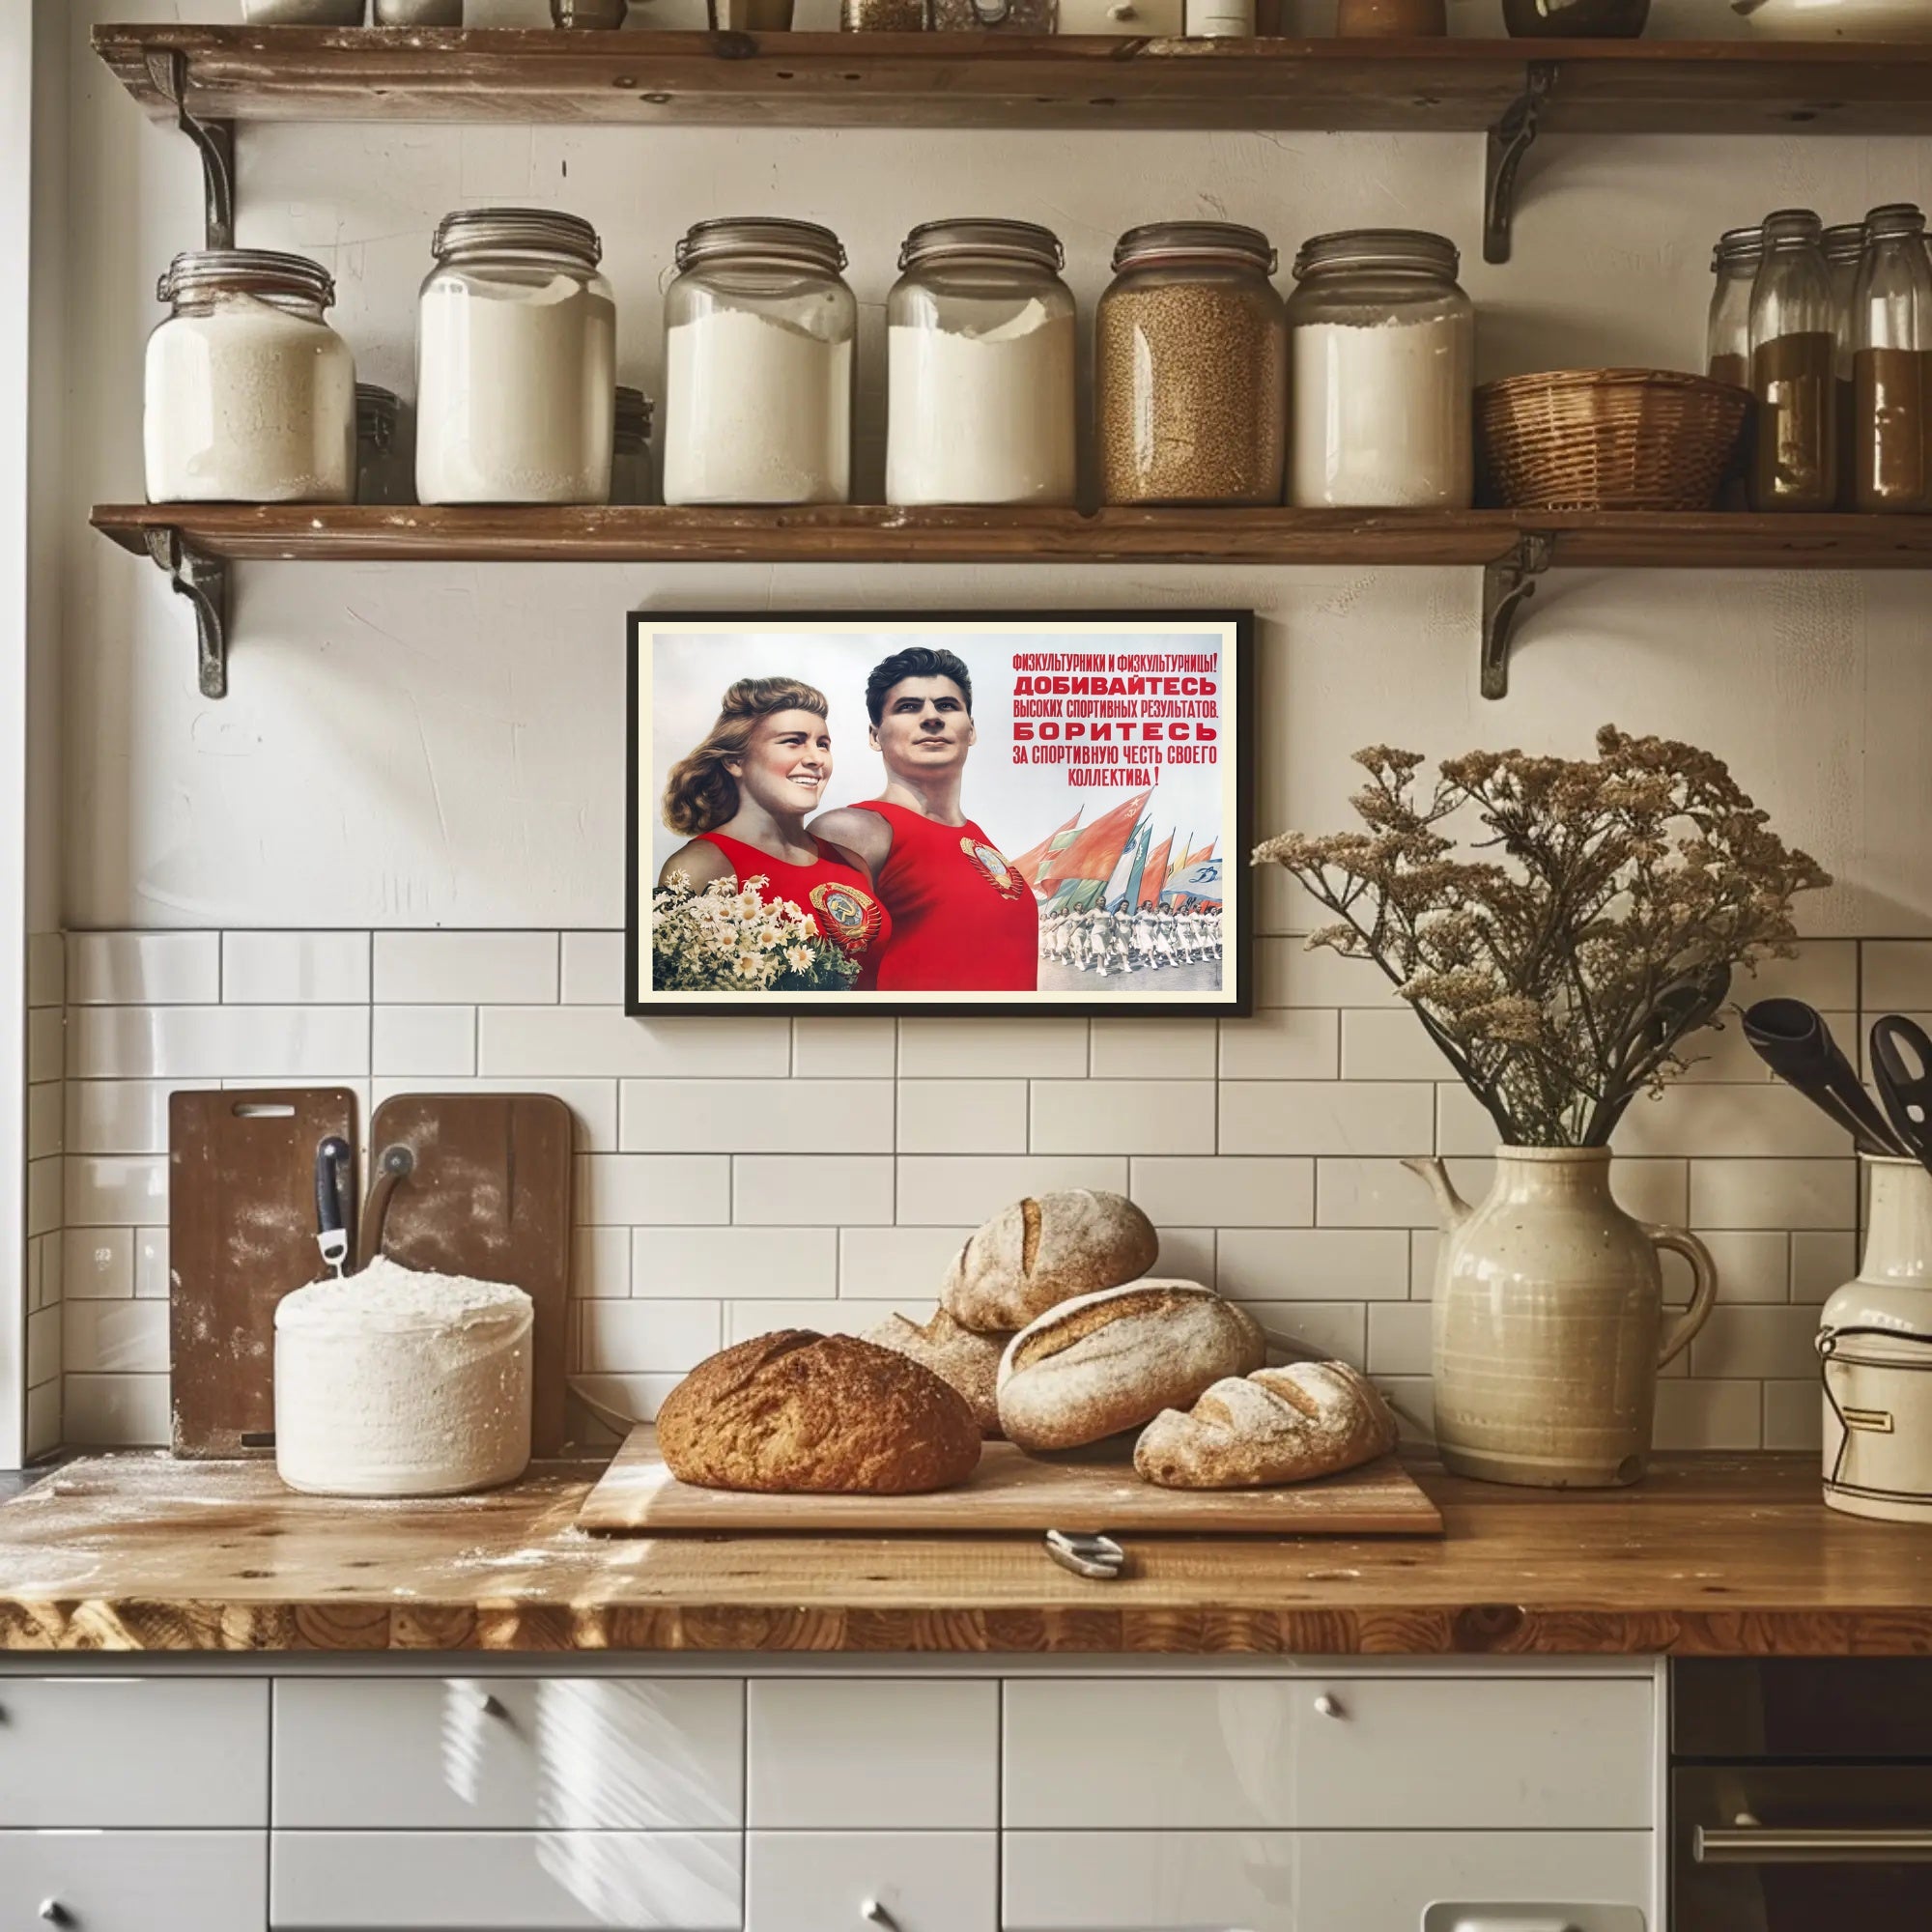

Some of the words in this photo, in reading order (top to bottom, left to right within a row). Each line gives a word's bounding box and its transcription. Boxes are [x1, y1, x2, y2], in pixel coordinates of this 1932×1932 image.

[1012, 653, 1106, 672] ФИЗКУЛЬТУРНИКИ
[1108, 654, 1115, 672] И
[1117, 653, 1217, 672] ФИЗКУЛЬТУРНИЦЫ!
[1013, 674, 1217, 696] ДОБИВАЙТЕСЬ
[1013, 699, 1063, 718] ВЫСОКИХ
[1066, 699, 1137, 718] СПОРТИВНЫХ
[1141, 699, 1219, 718] РЕЗУЛЬТАТОВ.
[1013, 722, 1217, 741] БОРИТЕСЬ
[1012, 746, 1028, 764] ЗА
[1032, 745, 1119, 764] СПОРТИВНУЮ
[1122, 746, 1163, 764] ЧЕСТЬ
[1167, 746, 1217, 764] СВОЕГО
